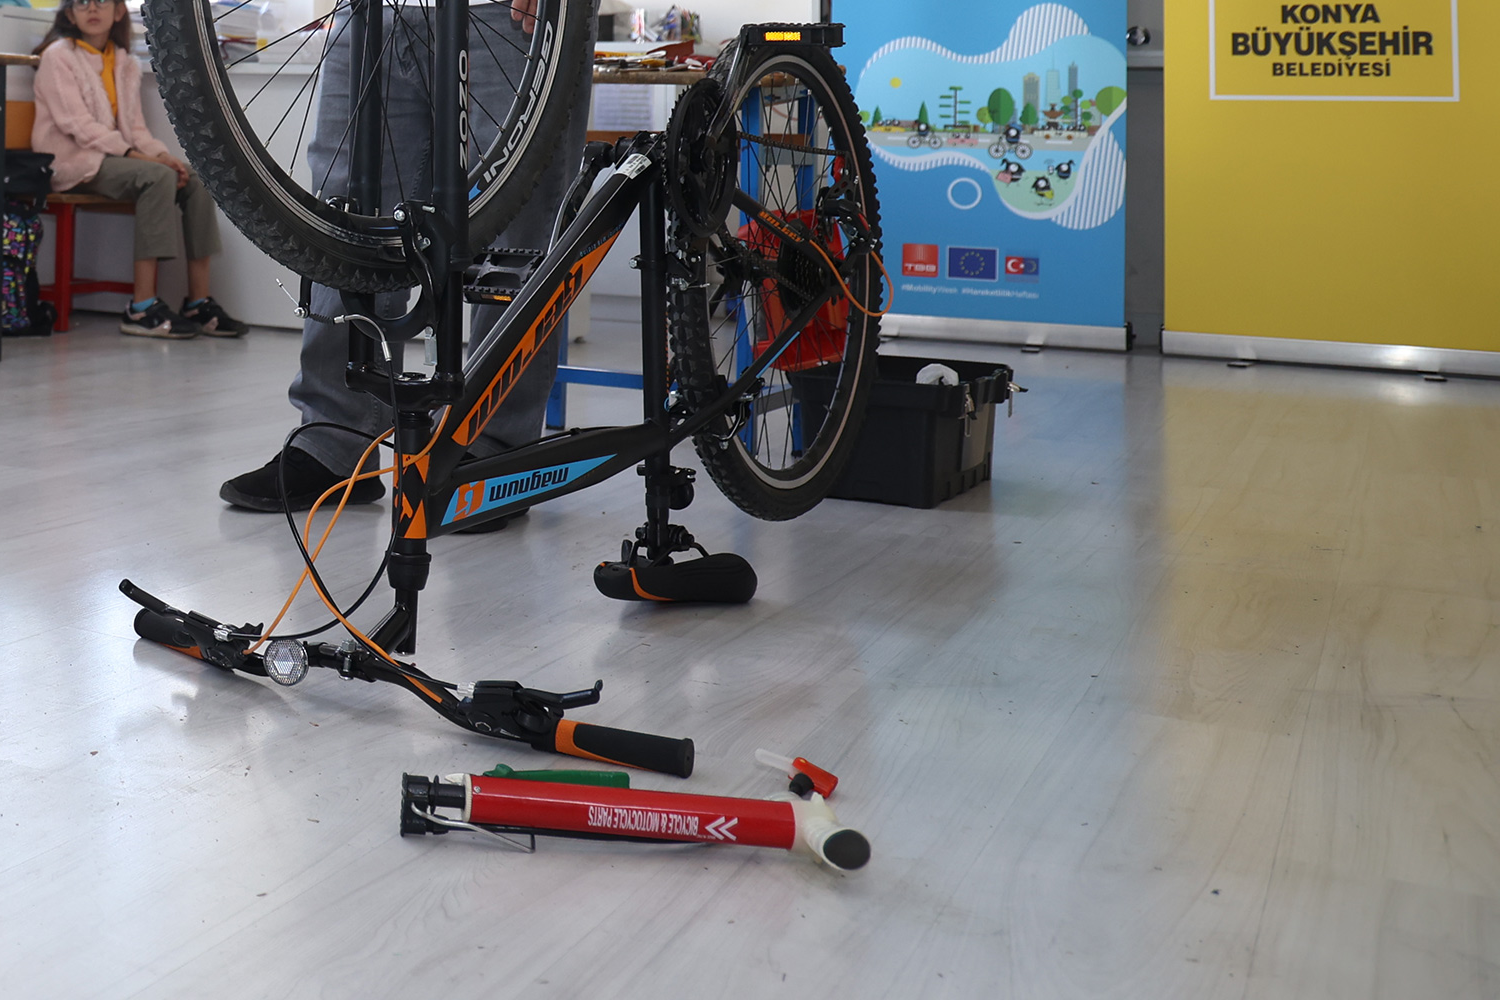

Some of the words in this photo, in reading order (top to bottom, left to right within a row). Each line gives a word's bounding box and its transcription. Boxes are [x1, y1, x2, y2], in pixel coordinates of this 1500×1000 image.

[1281, 3, 1381, 25] KONYA
[1231, 25, 1434, 60] BÜYÜKŞEHİR
[1272, 58, 1391, 77] BELEDİYESİ
[483, 20, 553, 184] GERONI
[489, 466, 570, 502] magnum
[587, 805, 613, 828] PARTS
[613, 808, 661, 833] MOTOCYCLE
[661, 812, 668, 834] &
[668, 813, 699, 836] BICYCLE
